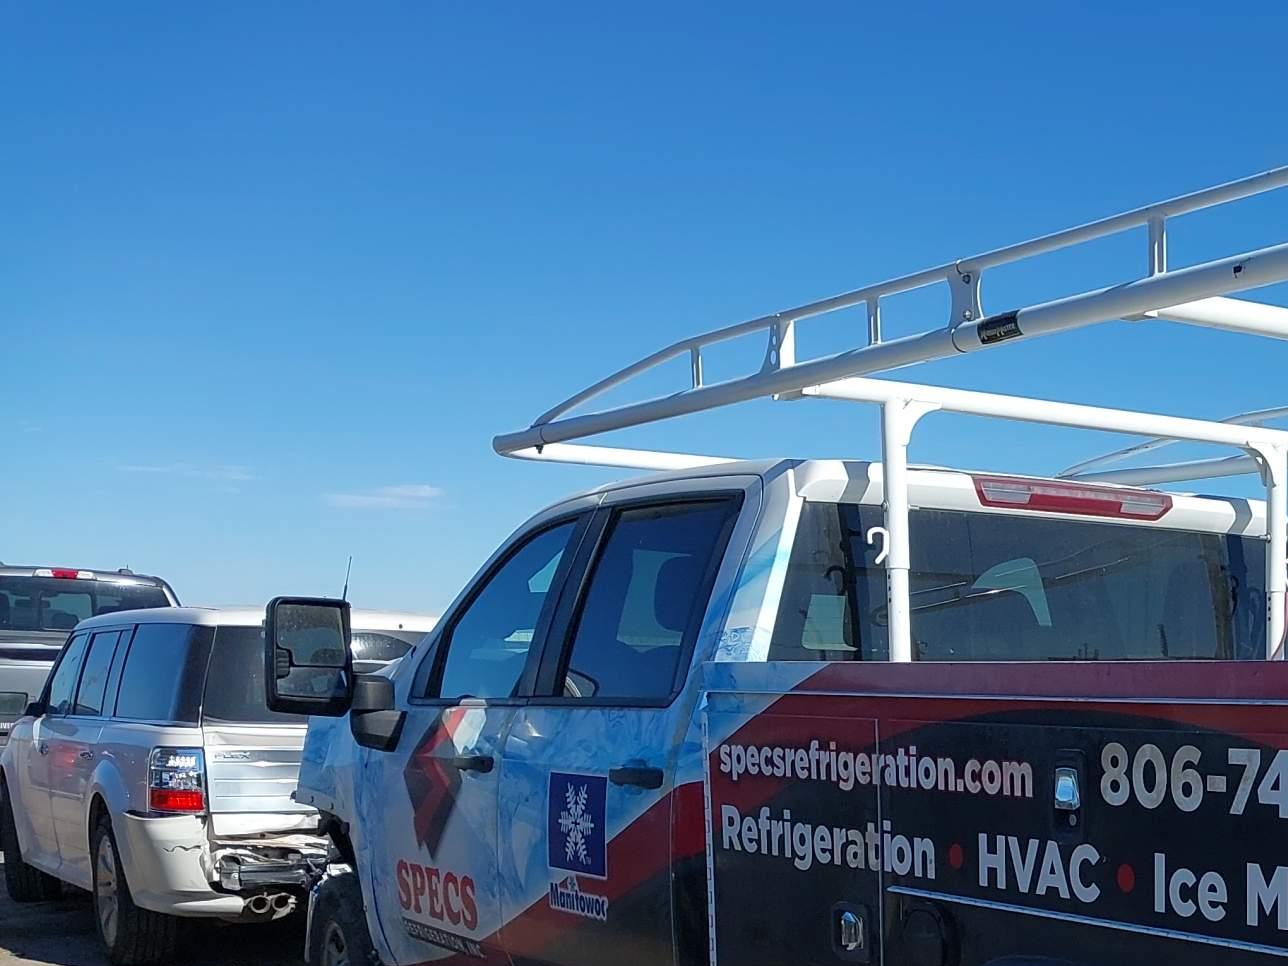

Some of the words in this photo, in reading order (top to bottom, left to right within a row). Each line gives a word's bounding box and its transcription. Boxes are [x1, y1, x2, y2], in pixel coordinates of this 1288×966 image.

[719, 740, 1034, 798] specsrefrigeration.com
[396, 859, 478, 931] SPECS
[721, 804, 936, 880] Refrigeration
[978, 832, 1101, 904] HVAC
[1153, 852, 1228, 922] Ice
[550, 881, 607, 919] Manitowoc
